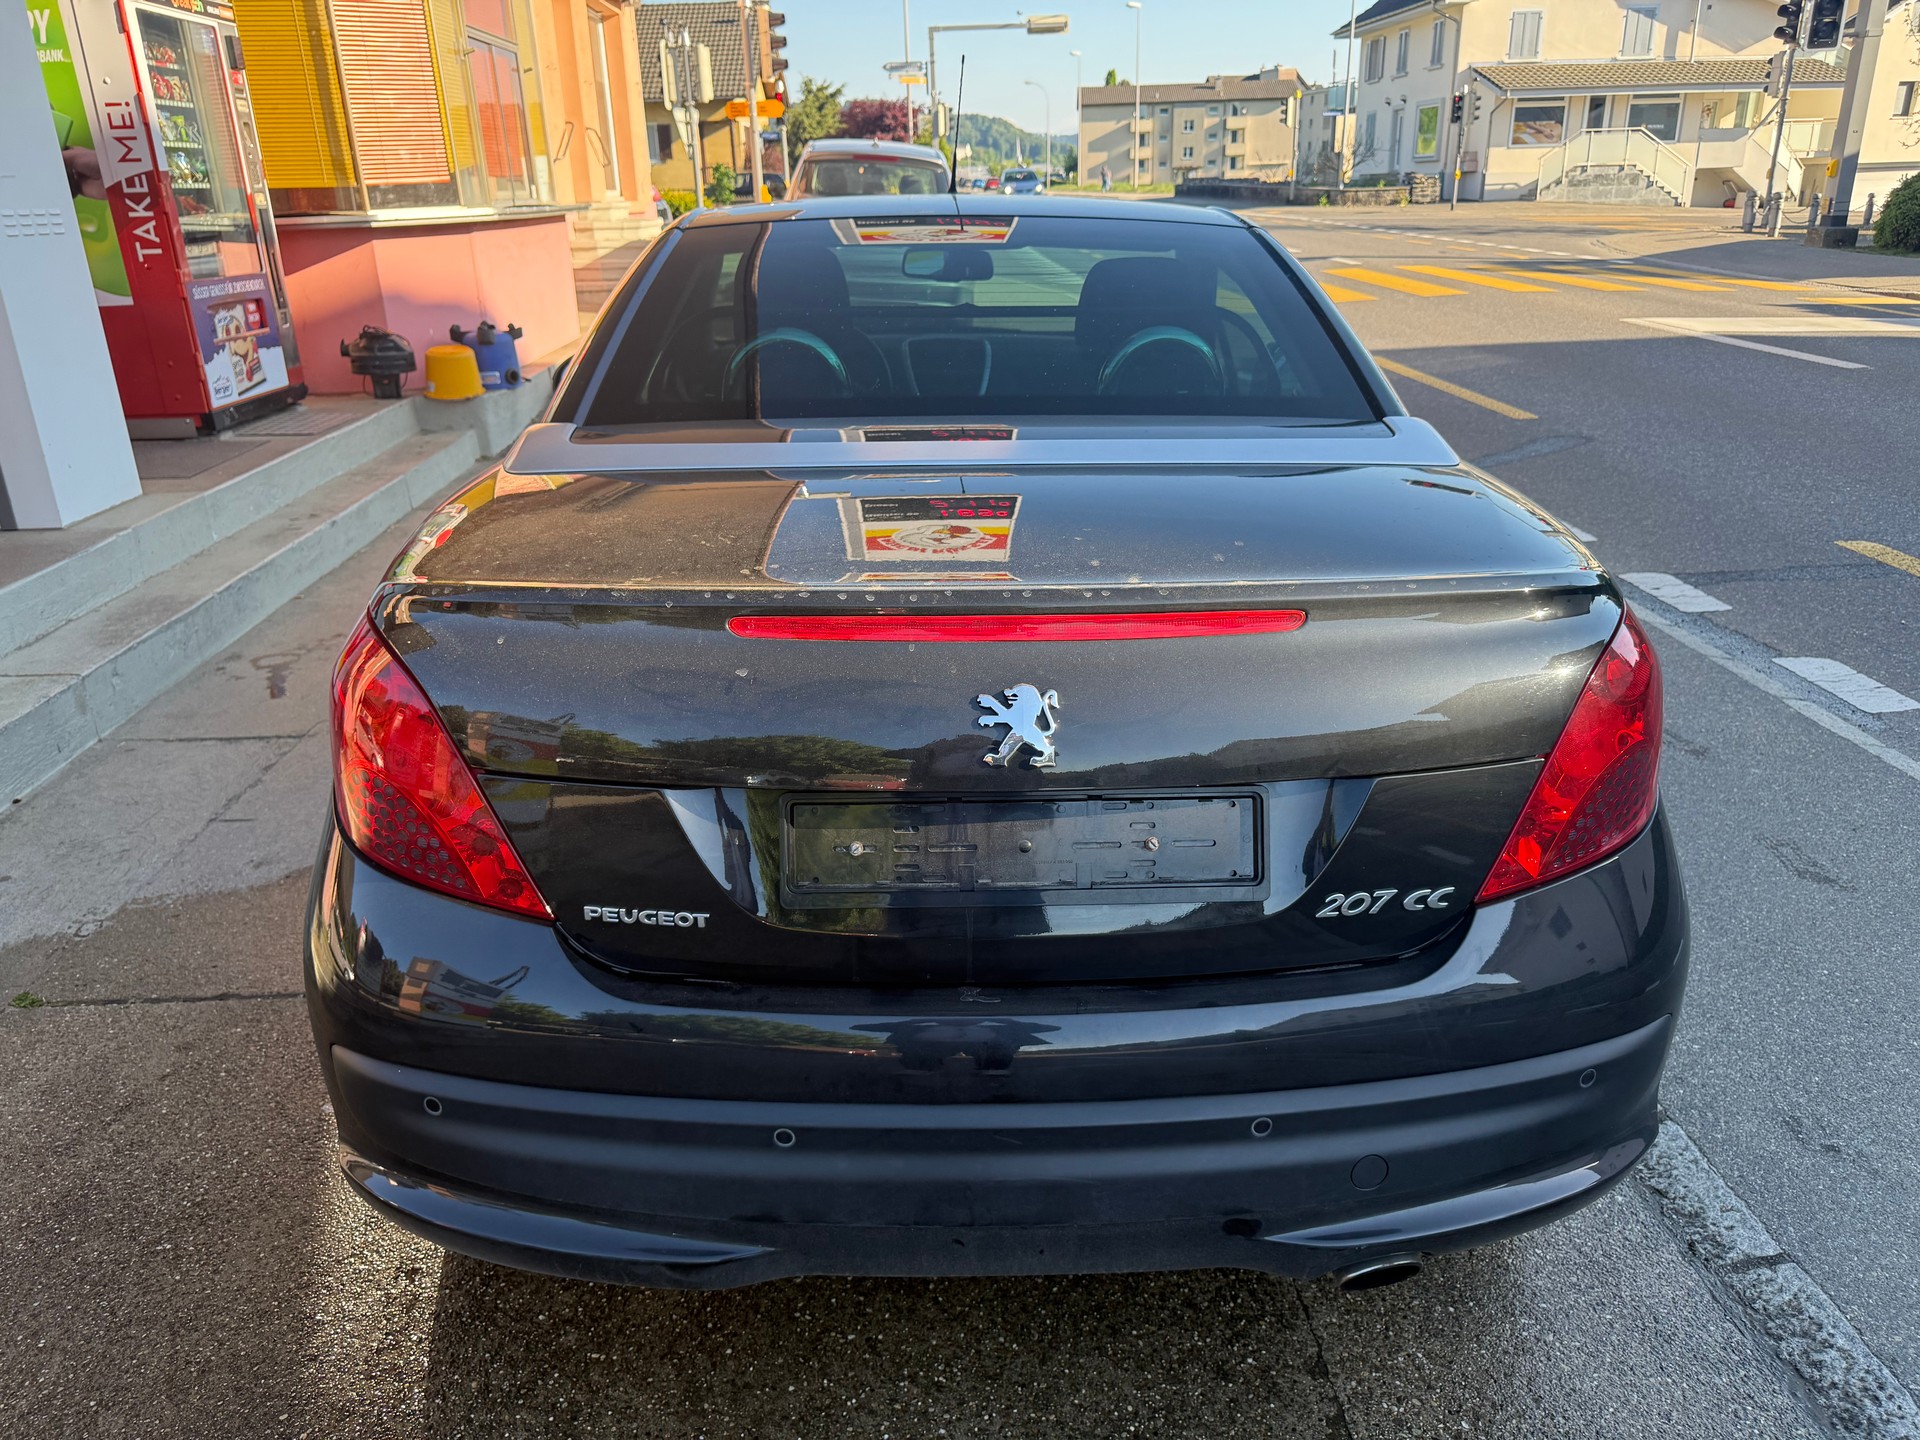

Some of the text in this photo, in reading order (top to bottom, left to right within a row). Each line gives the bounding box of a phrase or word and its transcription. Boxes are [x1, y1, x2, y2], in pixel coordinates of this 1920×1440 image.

[104, 101, 163, 263] TAKE ME!
[583, 905, 710, 928] PEUGEOT
[1315, 886, 1456, 918] 207 CC
